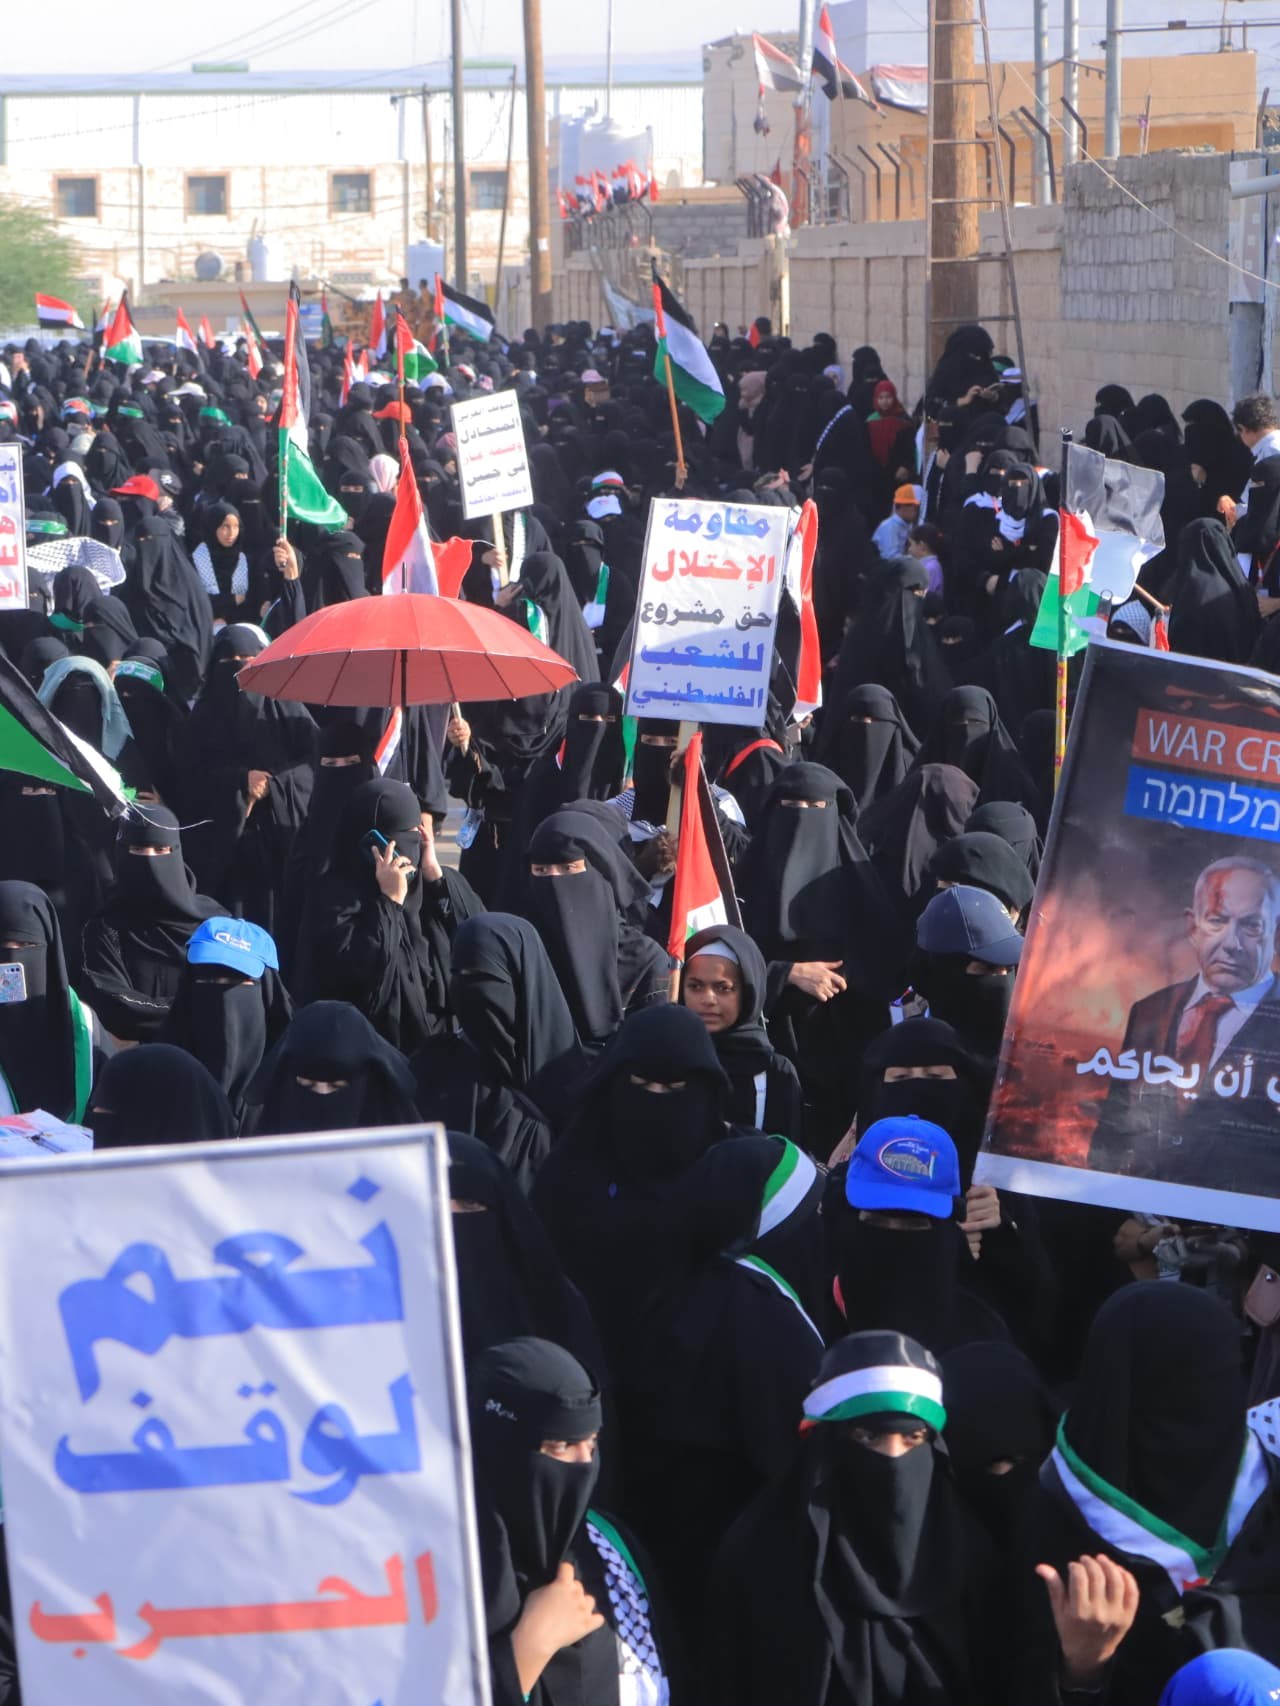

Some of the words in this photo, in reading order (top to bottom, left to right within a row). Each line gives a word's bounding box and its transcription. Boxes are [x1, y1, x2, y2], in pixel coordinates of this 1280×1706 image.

[663, 503, 770, 540] مقاومة
[651, 549, 776, 590] الإحتلال
[640, 600, 725, 626] مشروع
[735, 605, 773, 632] حق
[640, 640, 764, 672] للشعب
[631, 682, 764, 709] الفلسطيني
[1148, 717, 1227, 765] WAR
[1142, 777, 1280, 832] מלחמה
[1076, 1047, 1200, 1100] يحاكم
[1213, 1054, 1255, 1098] أن
[57, 1176, 406, 1405] نعم
[53, 1372, 422, 1506] لوقف
[29, 1550, 439, 1660] الحرب
